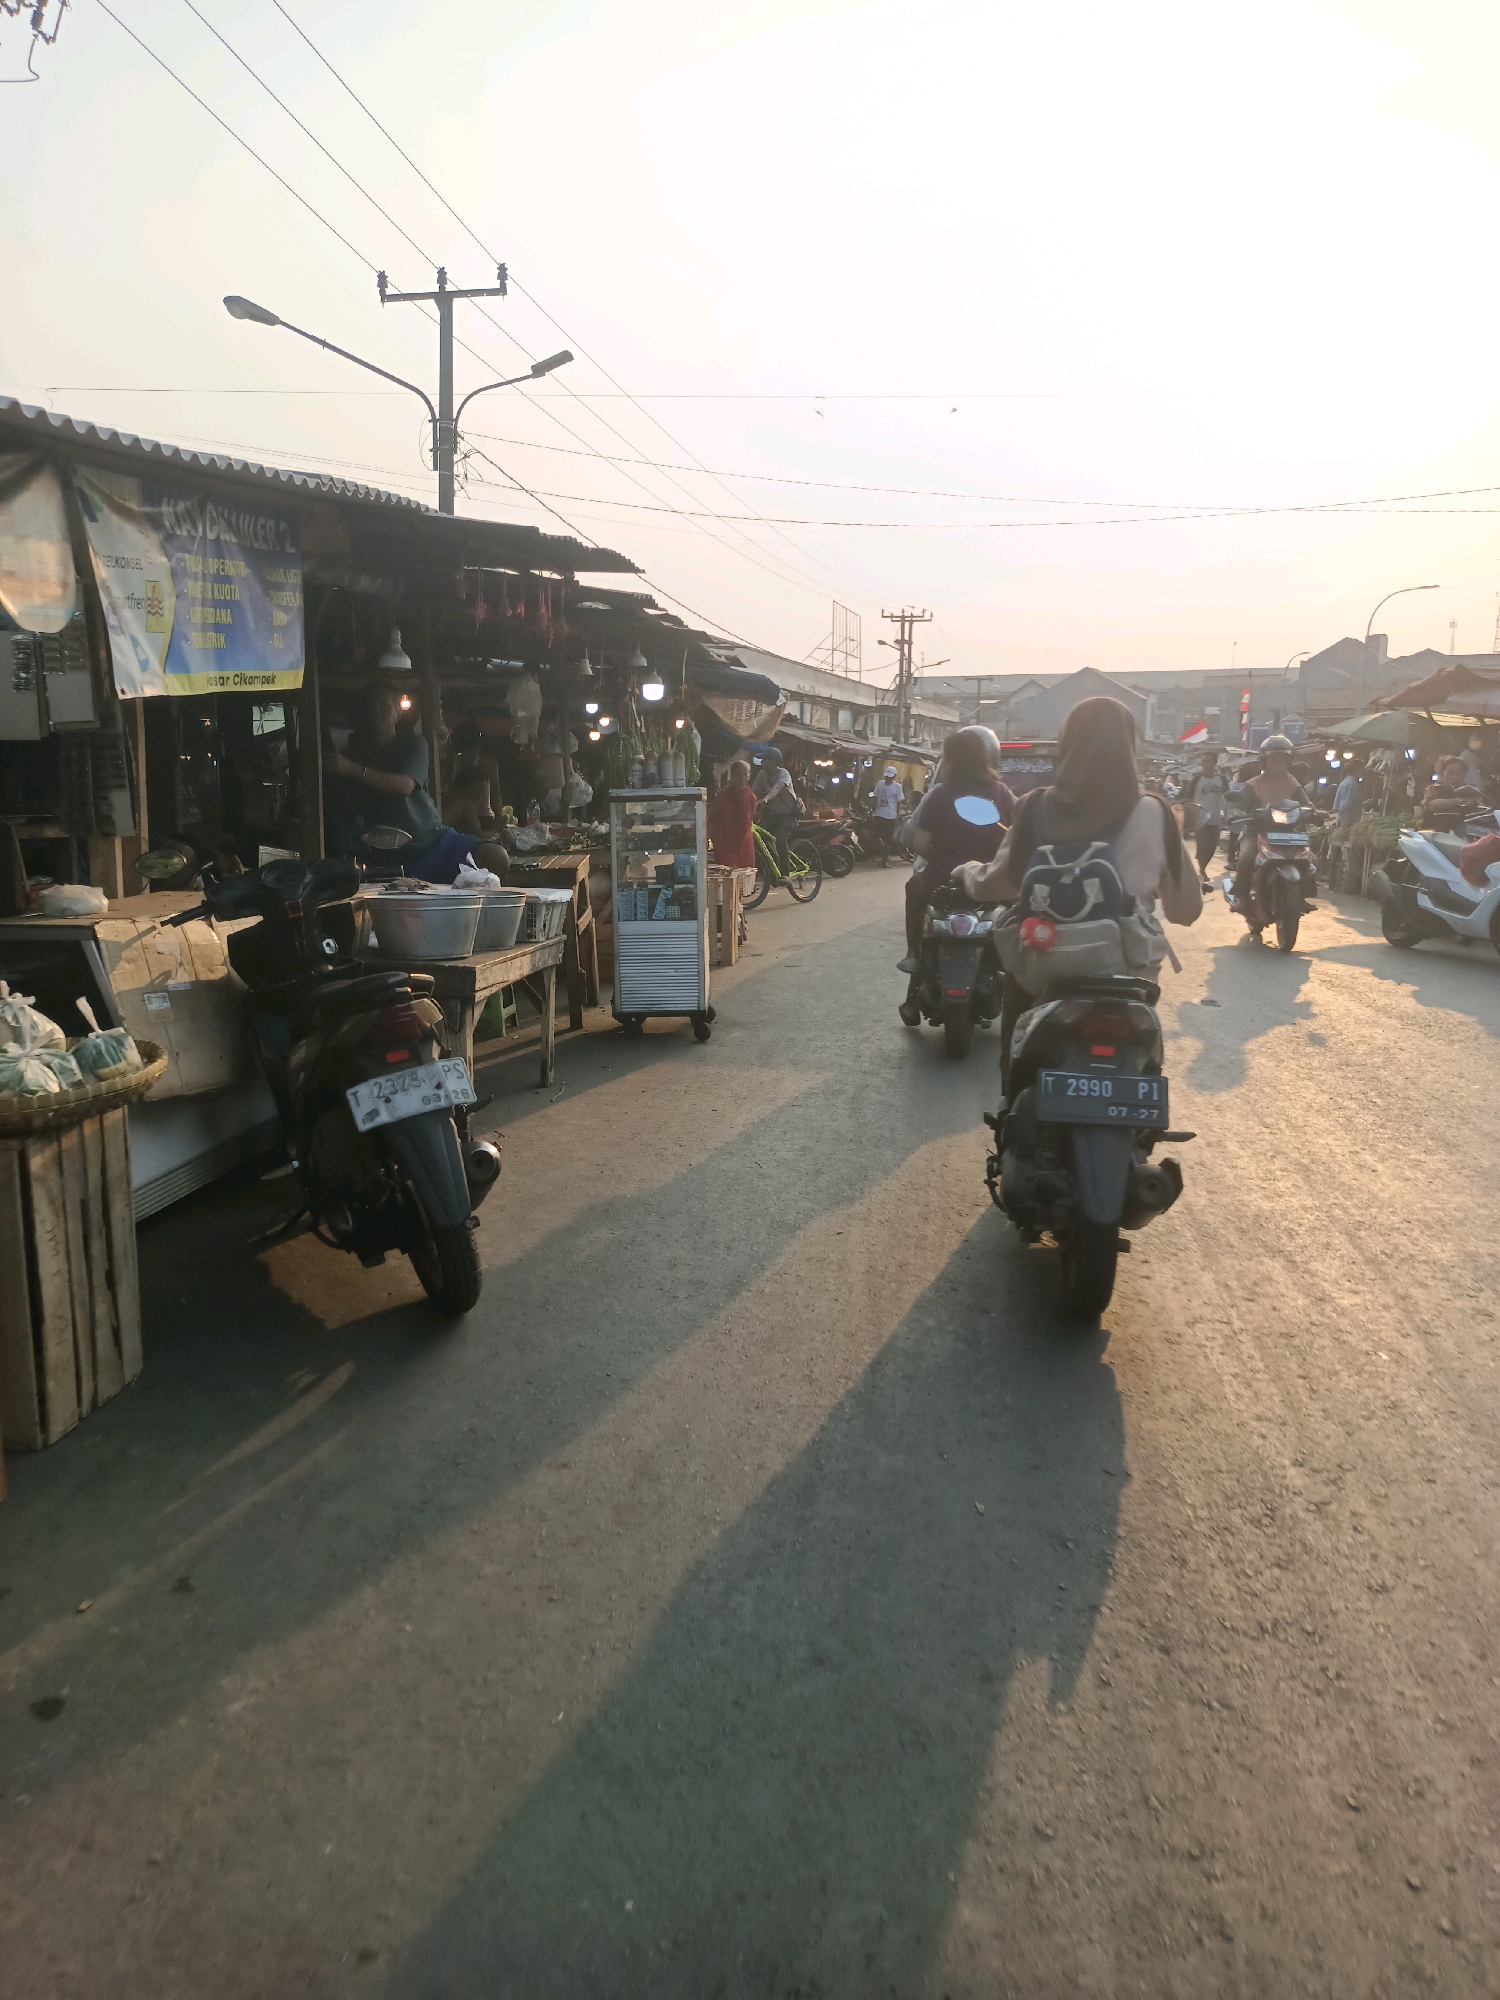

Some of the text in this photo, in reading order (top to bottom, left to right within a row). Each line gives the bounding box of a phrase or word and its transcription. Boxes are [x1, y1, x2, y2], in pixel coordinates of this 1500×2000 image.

[213, 583, 240, 601] KUOTA
[232, 672, 277, 689] Cikampek
[441, 1062, 465, 1081] PS
[1045, 1077, 1055, 1095] T
[1066, 1078, 1113, 1098] 2990
